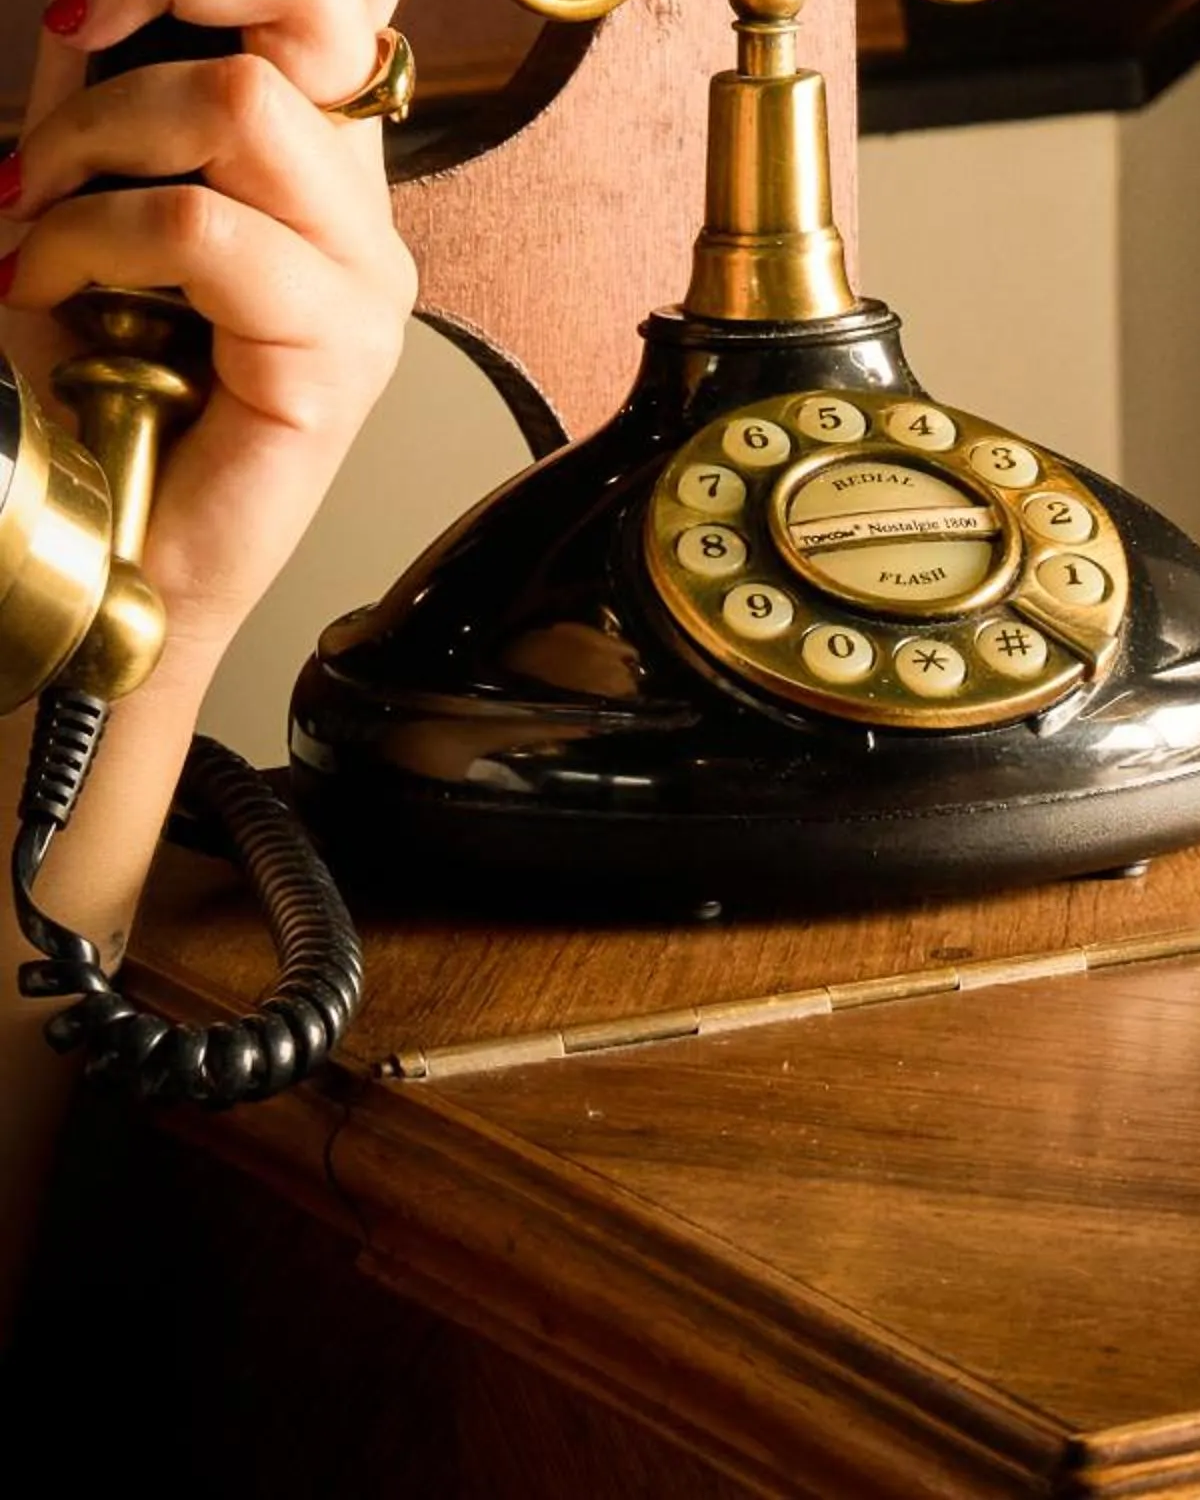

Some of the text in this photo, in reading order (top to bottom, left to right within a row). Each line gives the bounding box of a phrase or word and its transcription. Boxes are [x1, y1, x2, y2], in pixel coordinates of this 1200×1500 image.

[818, 405, 843, 430] 5
[909, 414, 933, 436] 4
[743, 427, 769, 450] 6
[992, 448, 1018, 471] 3
[699, 474, 722, 498] 7
[831, 472, 915, 491] REDIAL
[943, 516, 977, 530] 1800
[1047, 502, 1072, 525] 2
[701, 534, 727, 559] 8
[878, 567, 948, 586] FLASH
[1062, 564, 1082, 585] 1
[746, 594, 773, 619] 9
[828, 633, 855, 658] 0
